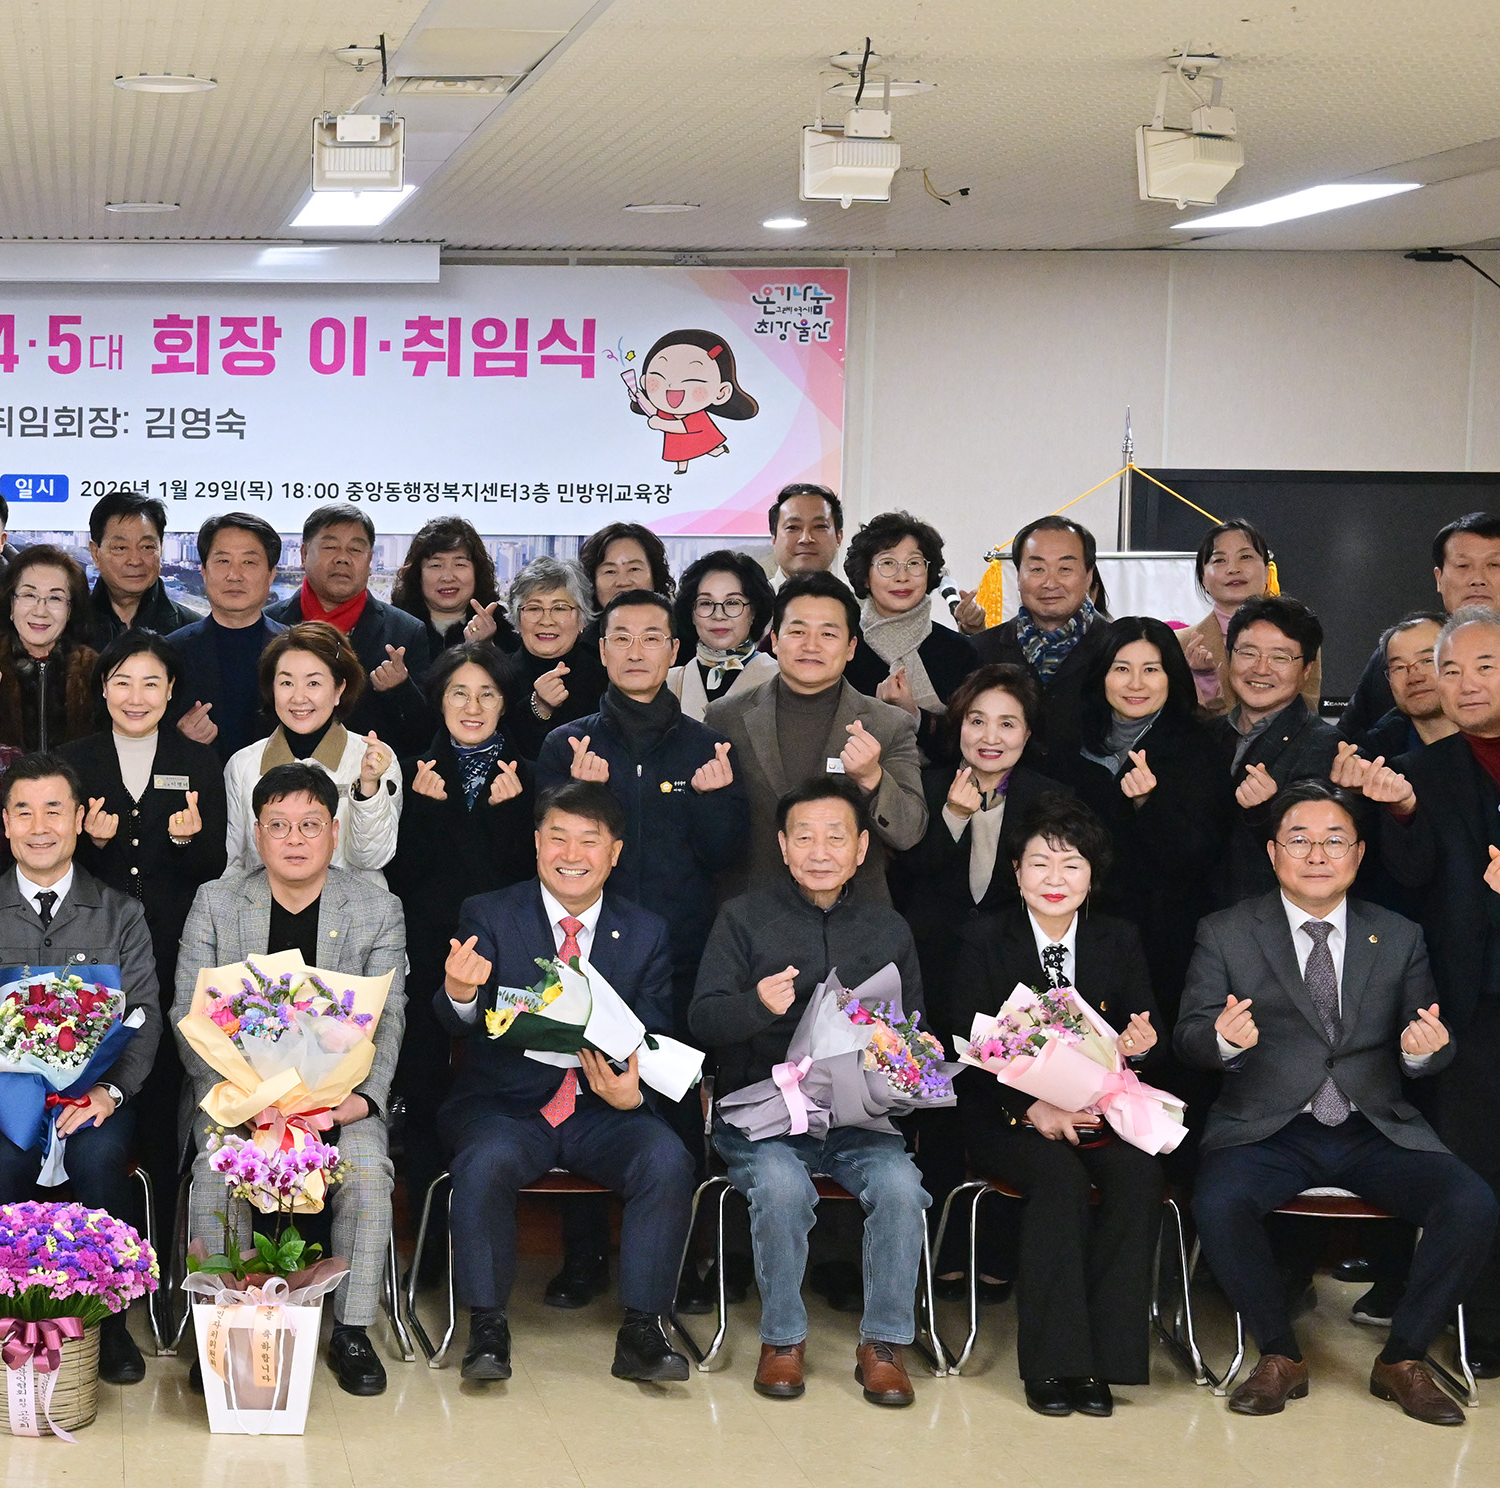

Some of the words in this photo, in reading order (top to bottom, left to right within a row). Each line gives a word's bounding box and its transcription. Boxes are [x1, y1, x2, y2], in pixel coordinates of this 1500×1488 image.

[752, 285, 833, 315] 온기나눔
[151, 313, 282, 376] 회장
[309, 315, 597, 379] 이·취임식
[754, 319, 831, 343] 최강울산
[145, 406, 247, 440] 김영숙
[14, 477, 55, 498] 일시
[80, 479, 150, 499] 2026년
[158, 480, 188, 500] 1월
[194, 480, 273, 501] 29일(목)
[281, 482, 340, 499] 18:00
[345, 481, 551, 503] 중앙동행정복지센터3층
[557, 482, 673, 504] 민방위교육장
[261, 1329, 273, 1383] 축하합니다
